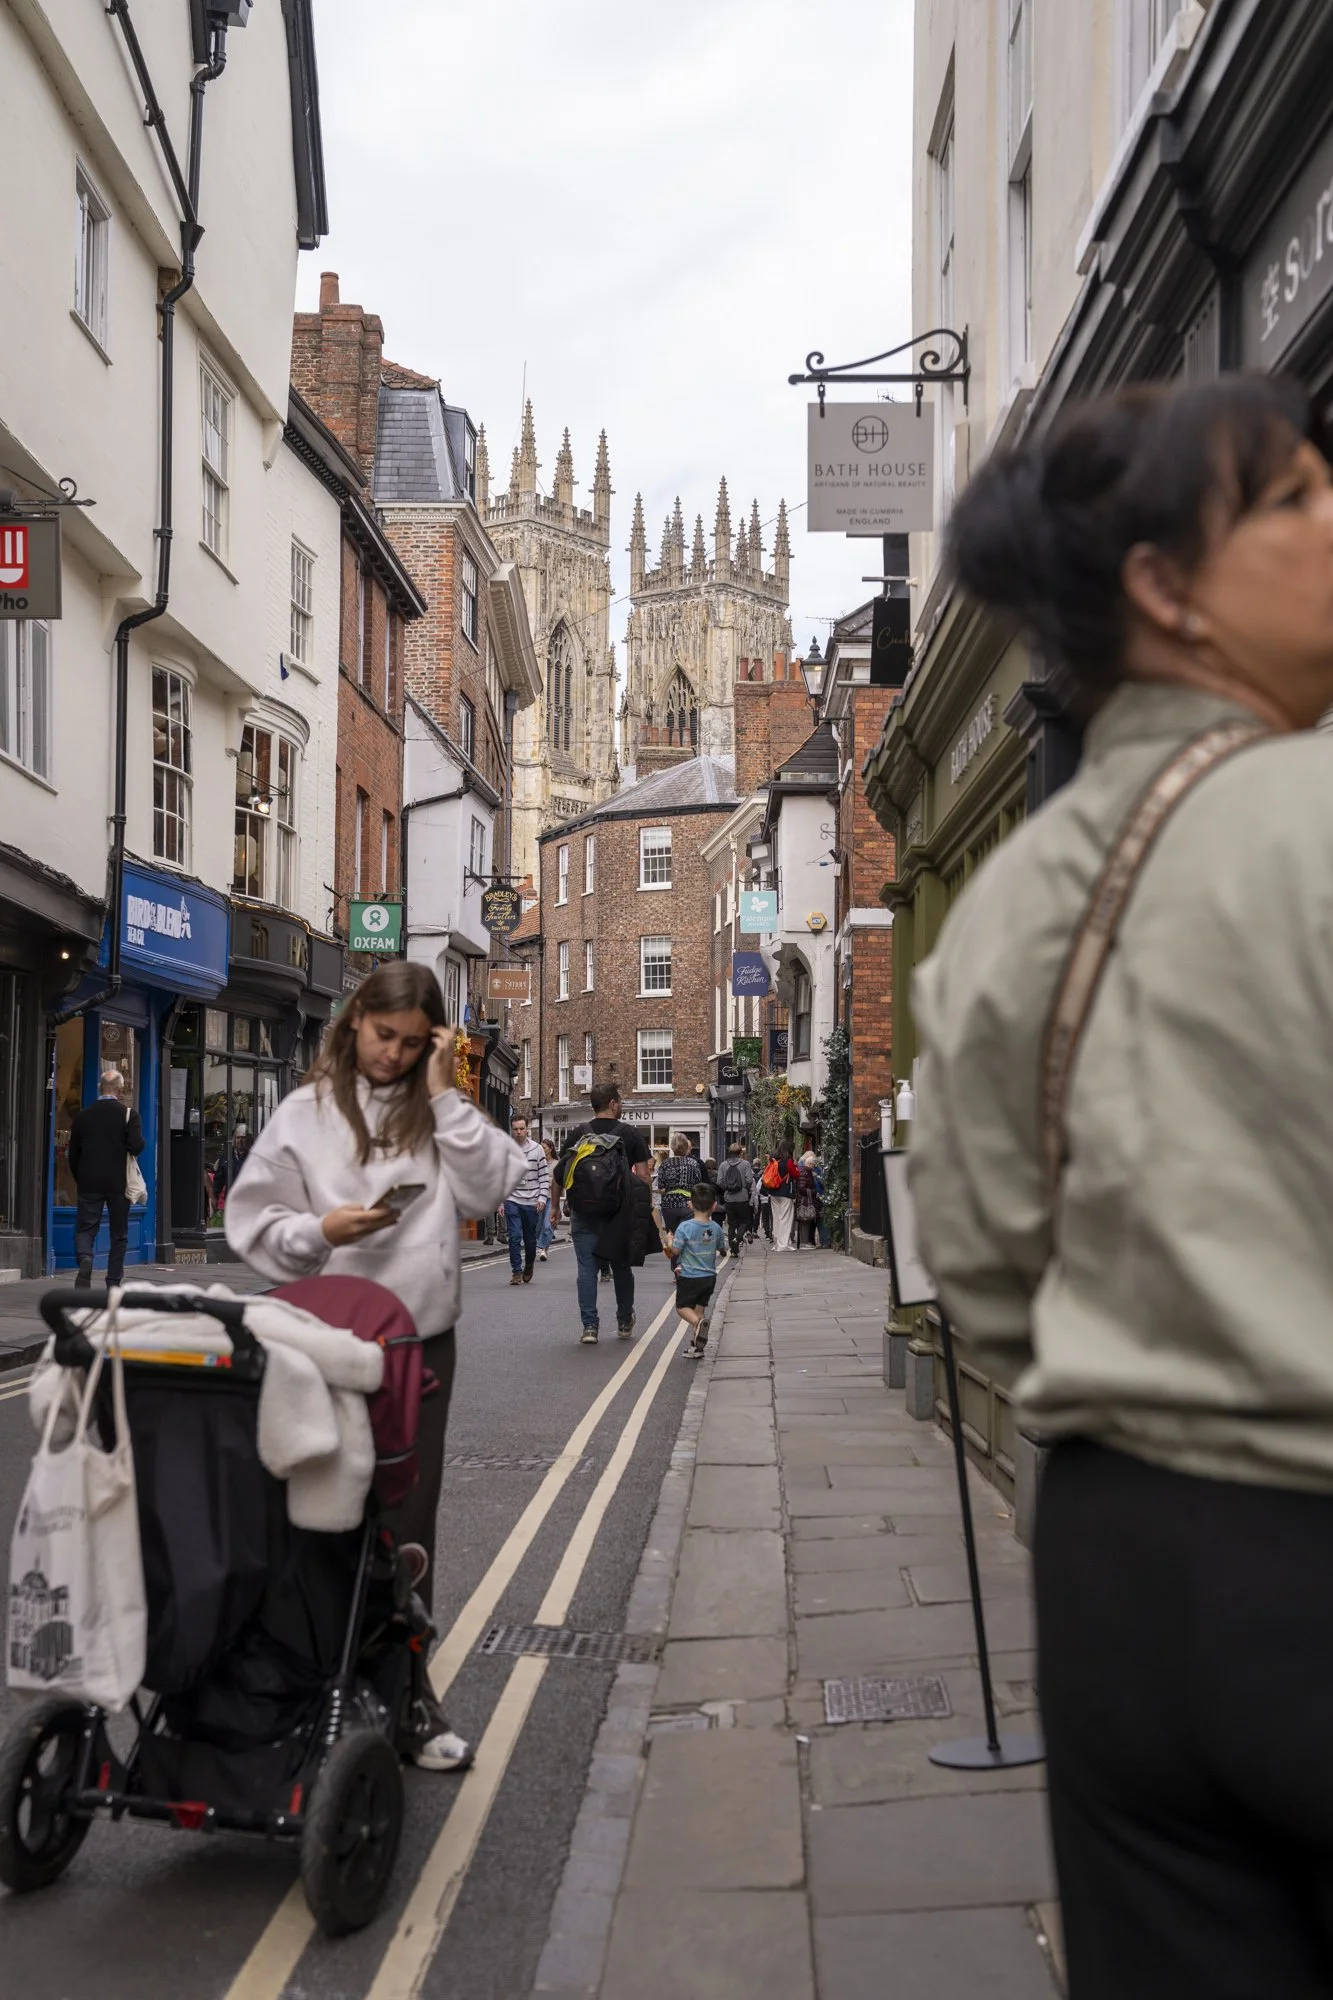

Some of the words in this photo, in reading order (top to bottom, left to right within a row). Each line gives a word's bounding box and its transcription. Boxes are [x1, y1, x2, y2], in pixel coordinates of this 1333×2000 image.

[814, 463, 859, 477] BATH
[868, 463, 926, 477] HOUSE
[353, 936, 395, 950] OXFAM
[736, 965, 762, 976] Fudge
[736, 973, 767, 986] Kitchen
[620, 1111, 654, 1120] ZENDI
